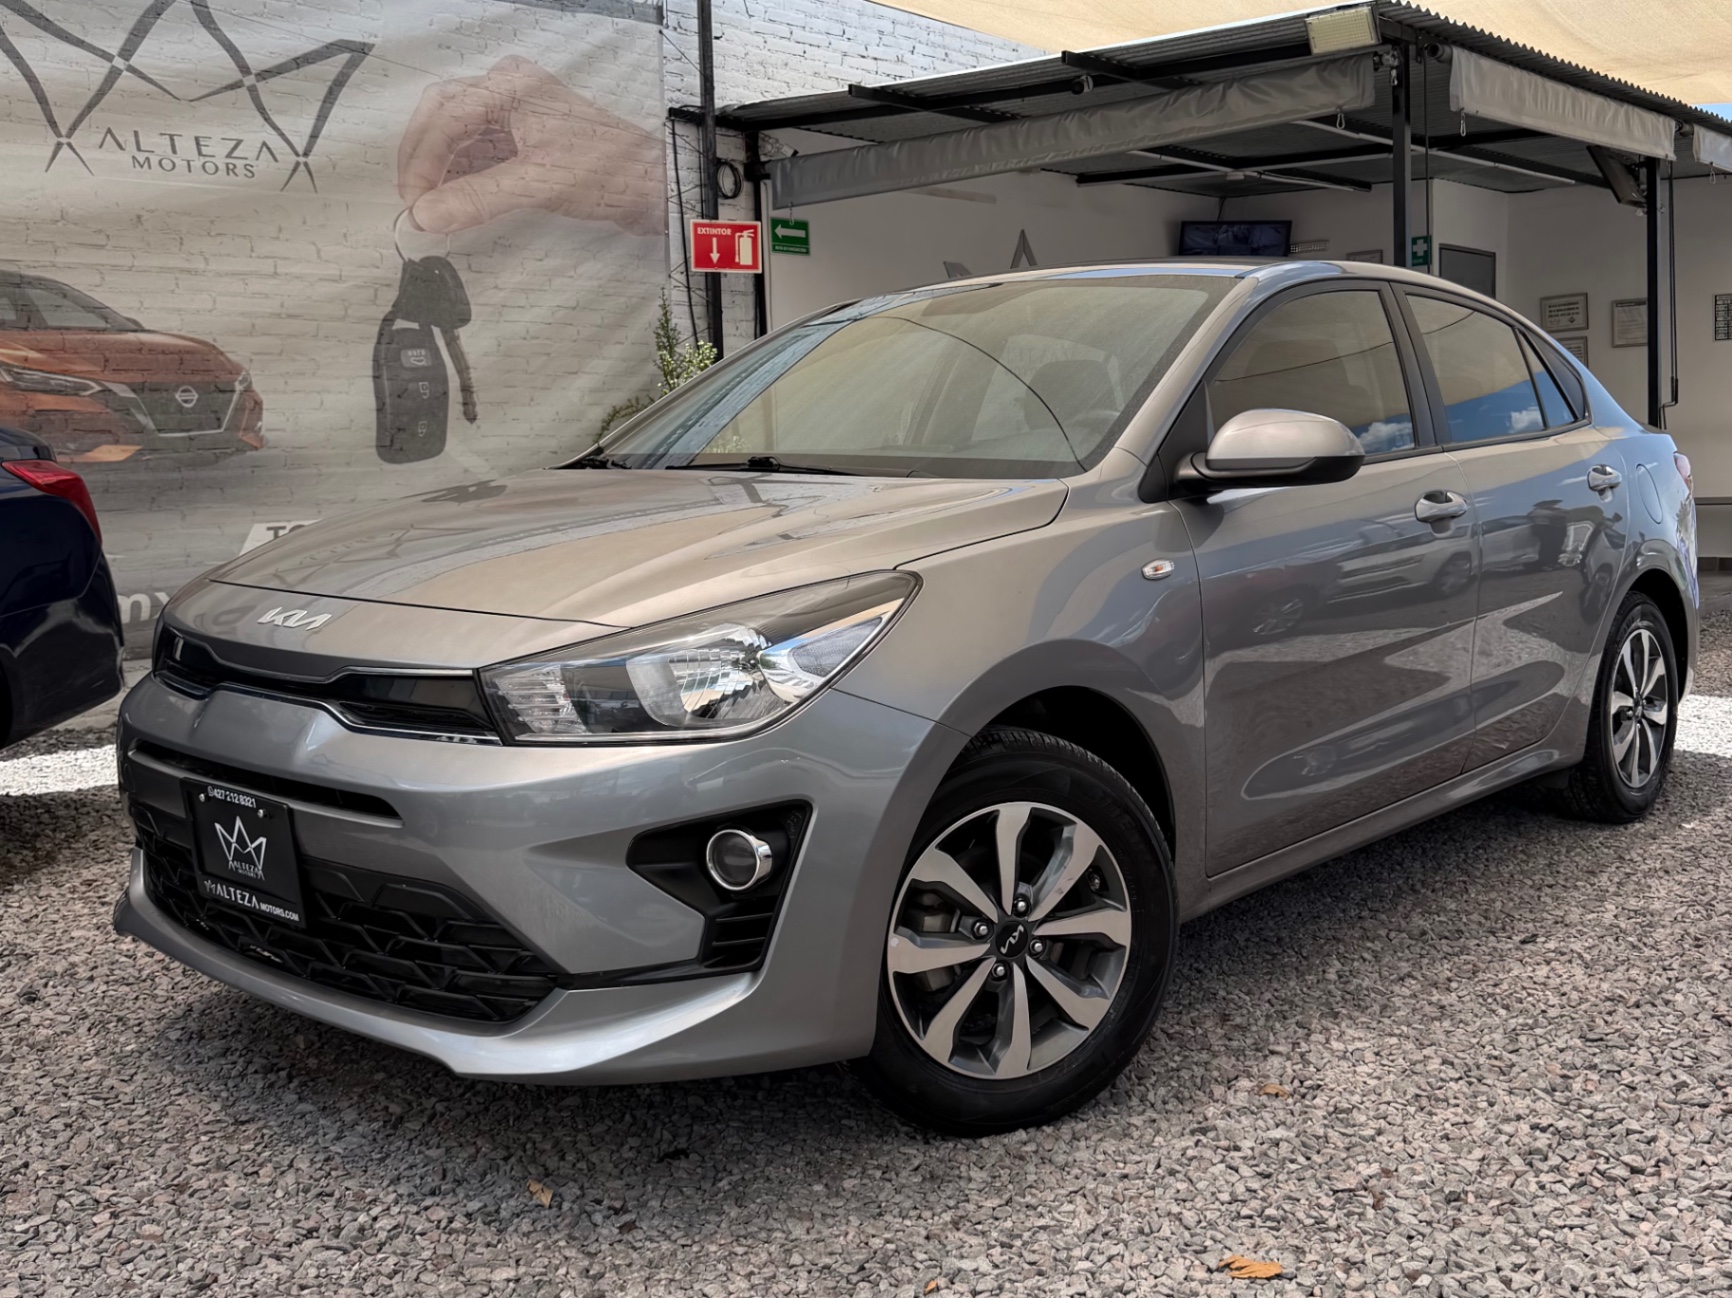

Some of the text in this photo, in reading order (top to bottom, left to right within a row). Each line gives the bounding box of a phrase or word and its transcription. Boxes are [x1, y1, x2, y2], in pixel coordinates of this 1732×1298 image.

[98, 126, 280, 163] ALTEZA
[131, 154, 256, 179] MOTORS
[697, 227, 732, 236] EXTINTOR
